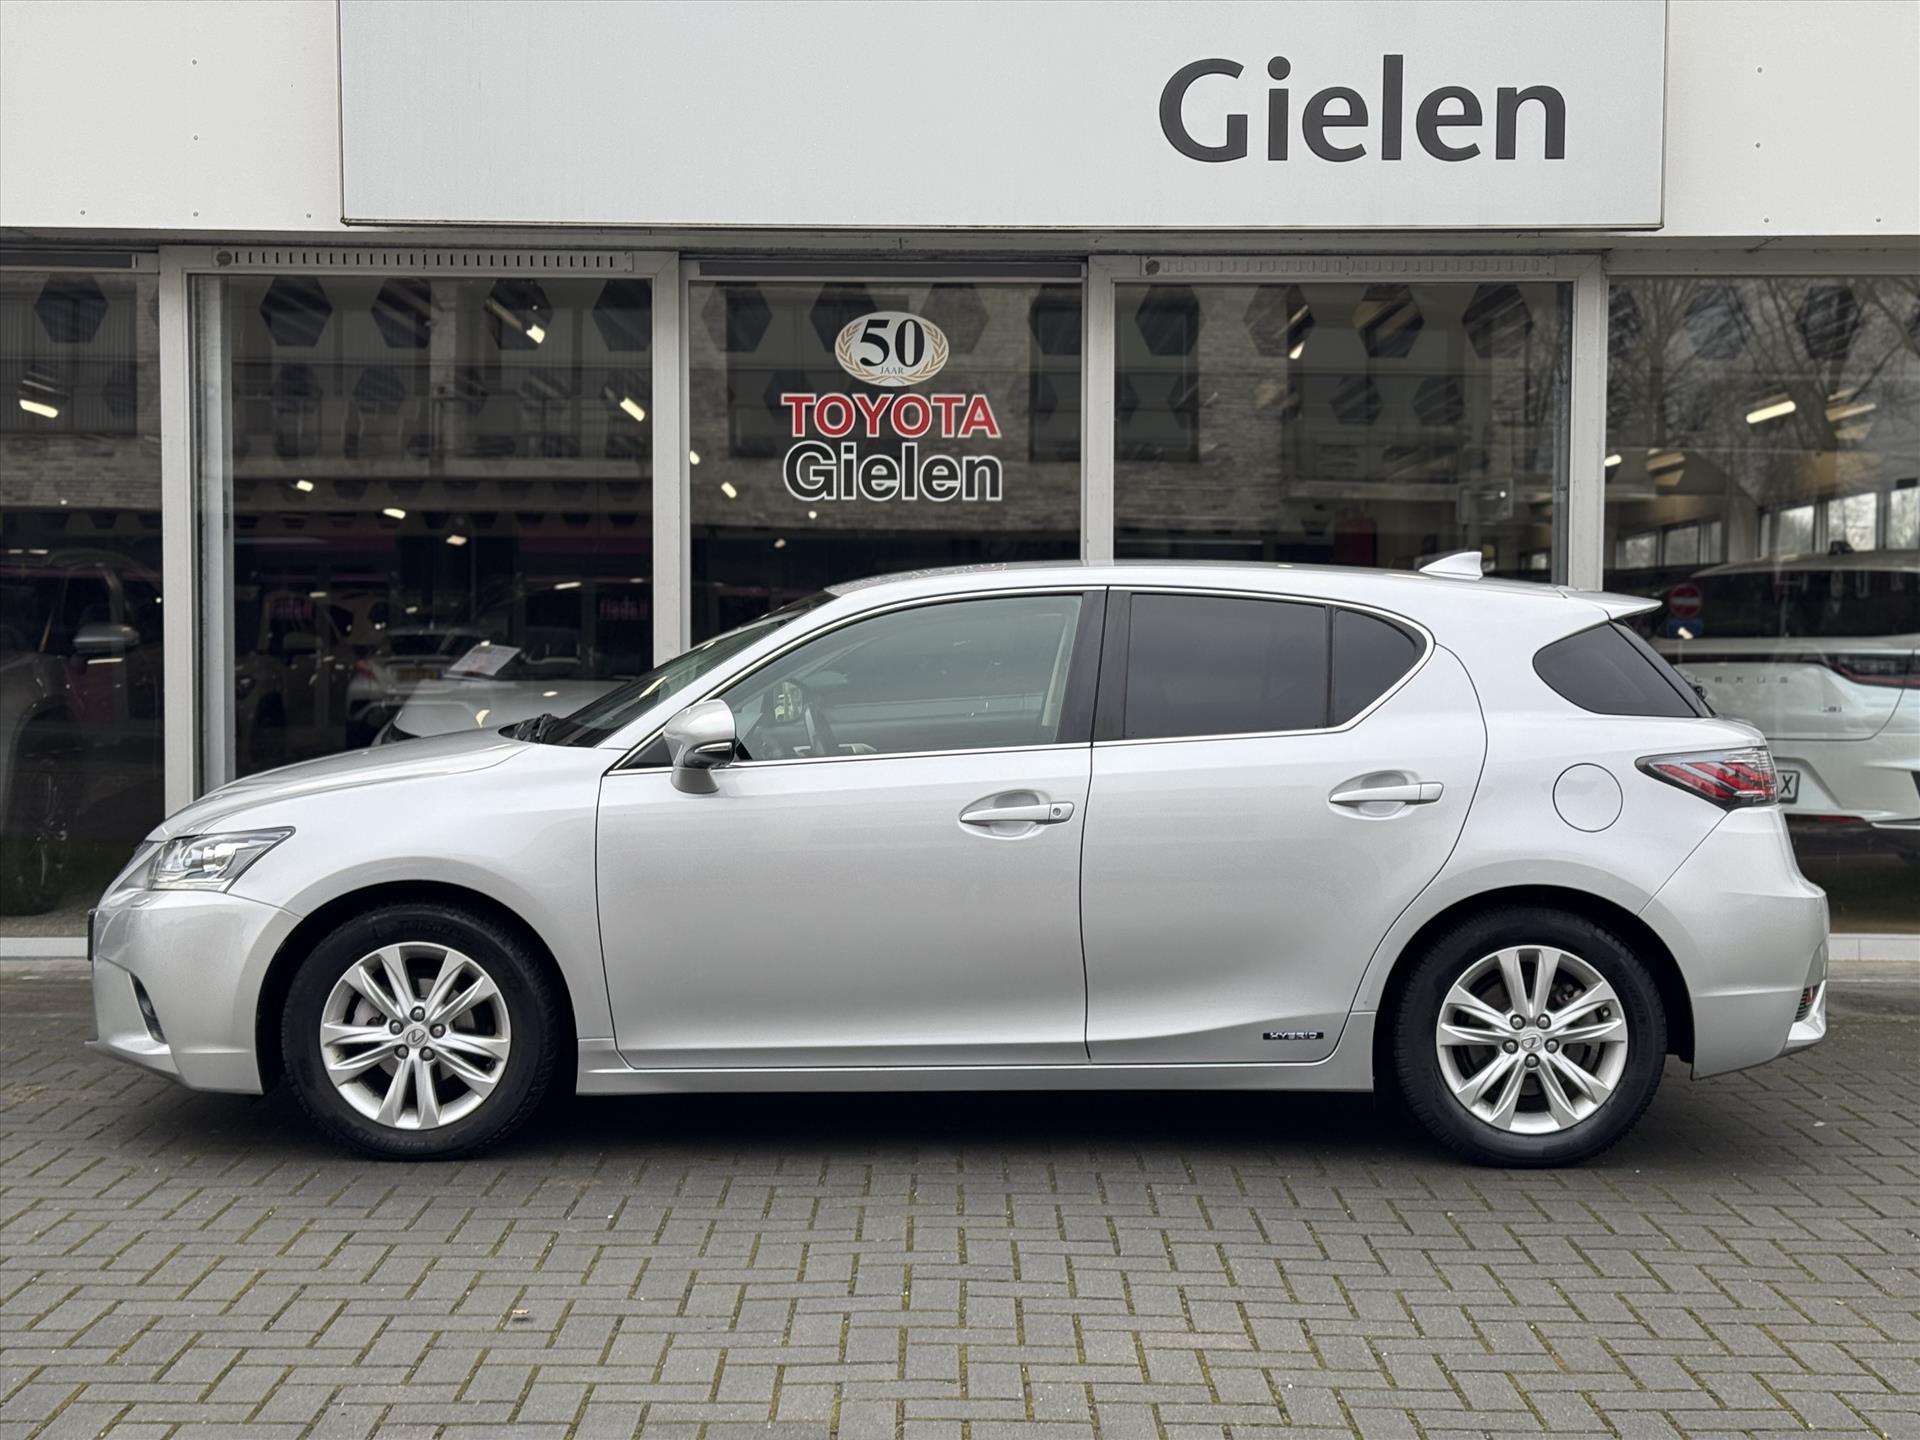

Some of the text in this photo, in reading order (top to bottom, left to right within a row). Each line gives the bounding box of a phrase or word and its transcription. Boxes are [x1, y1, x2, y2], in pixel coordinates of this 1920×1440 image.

[1159, 54, 1566, 163] Gielen
[860, 319, 925, 367] 50
[880, 366, 904, 375] JAAR
[781, 393, 1002, 439] TOYOTA
[783, 440, 1003, 502] Gielen
